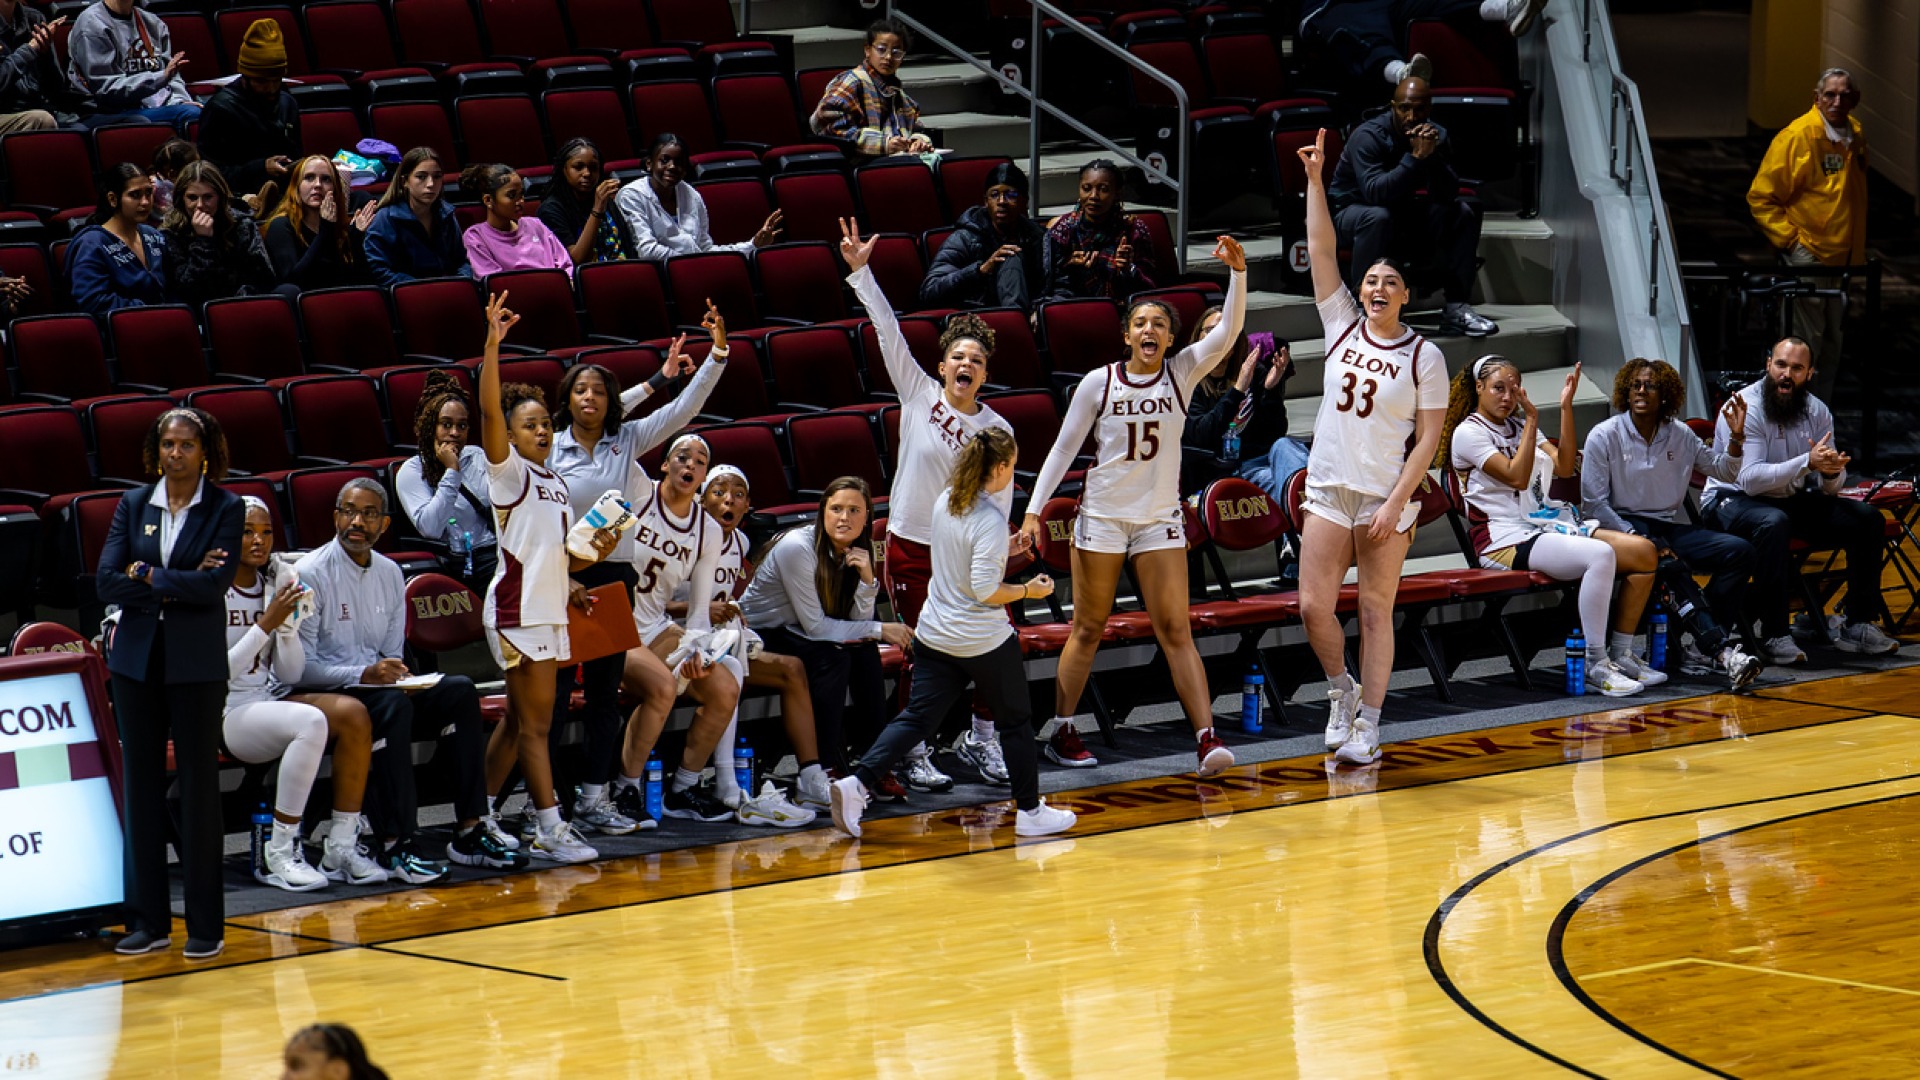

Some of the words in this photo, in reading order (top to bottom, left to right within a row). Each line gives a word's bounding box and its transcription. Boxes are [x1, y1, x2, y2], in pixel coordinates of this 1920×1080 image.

[1341, 348, 1401, 380] ELON
[1113, 397, 1173, 416] ELON
[1336, 372, 1378, 419] 33
[1124, 421, 1160, 462] 15
[535, 485, 569, 505] ELO
[1216, 495, 1271, 521] ELON
[635, 525, 692, 562] ELON
[637, 556, 667, 593] 5
[715, 567, 739, 585] ON
[411, 590, 473, 619] ELON
[9, 831, 43, 856] OF
